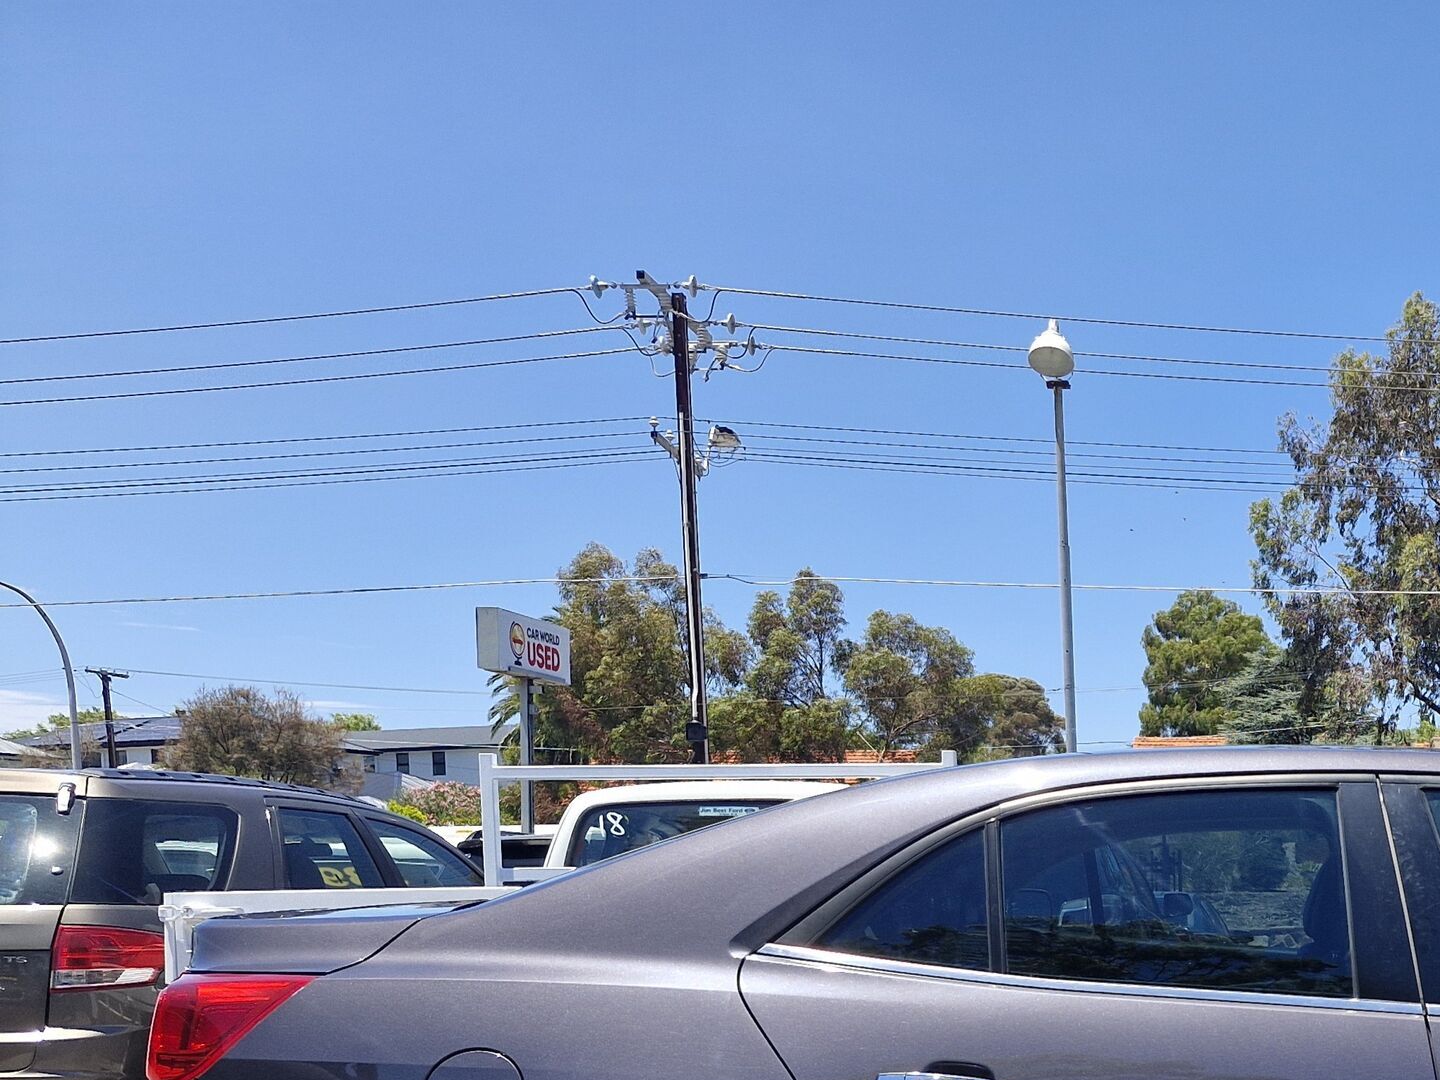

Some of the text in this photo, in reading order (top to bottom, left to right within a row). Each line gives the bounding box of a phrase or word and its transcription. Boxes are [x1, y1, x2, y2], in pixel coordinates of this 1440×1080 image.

[526, 627, 560, 646] CAR WORLD
[527, 641, 560, 672] USED
[599, 811, 626, 837] 18
